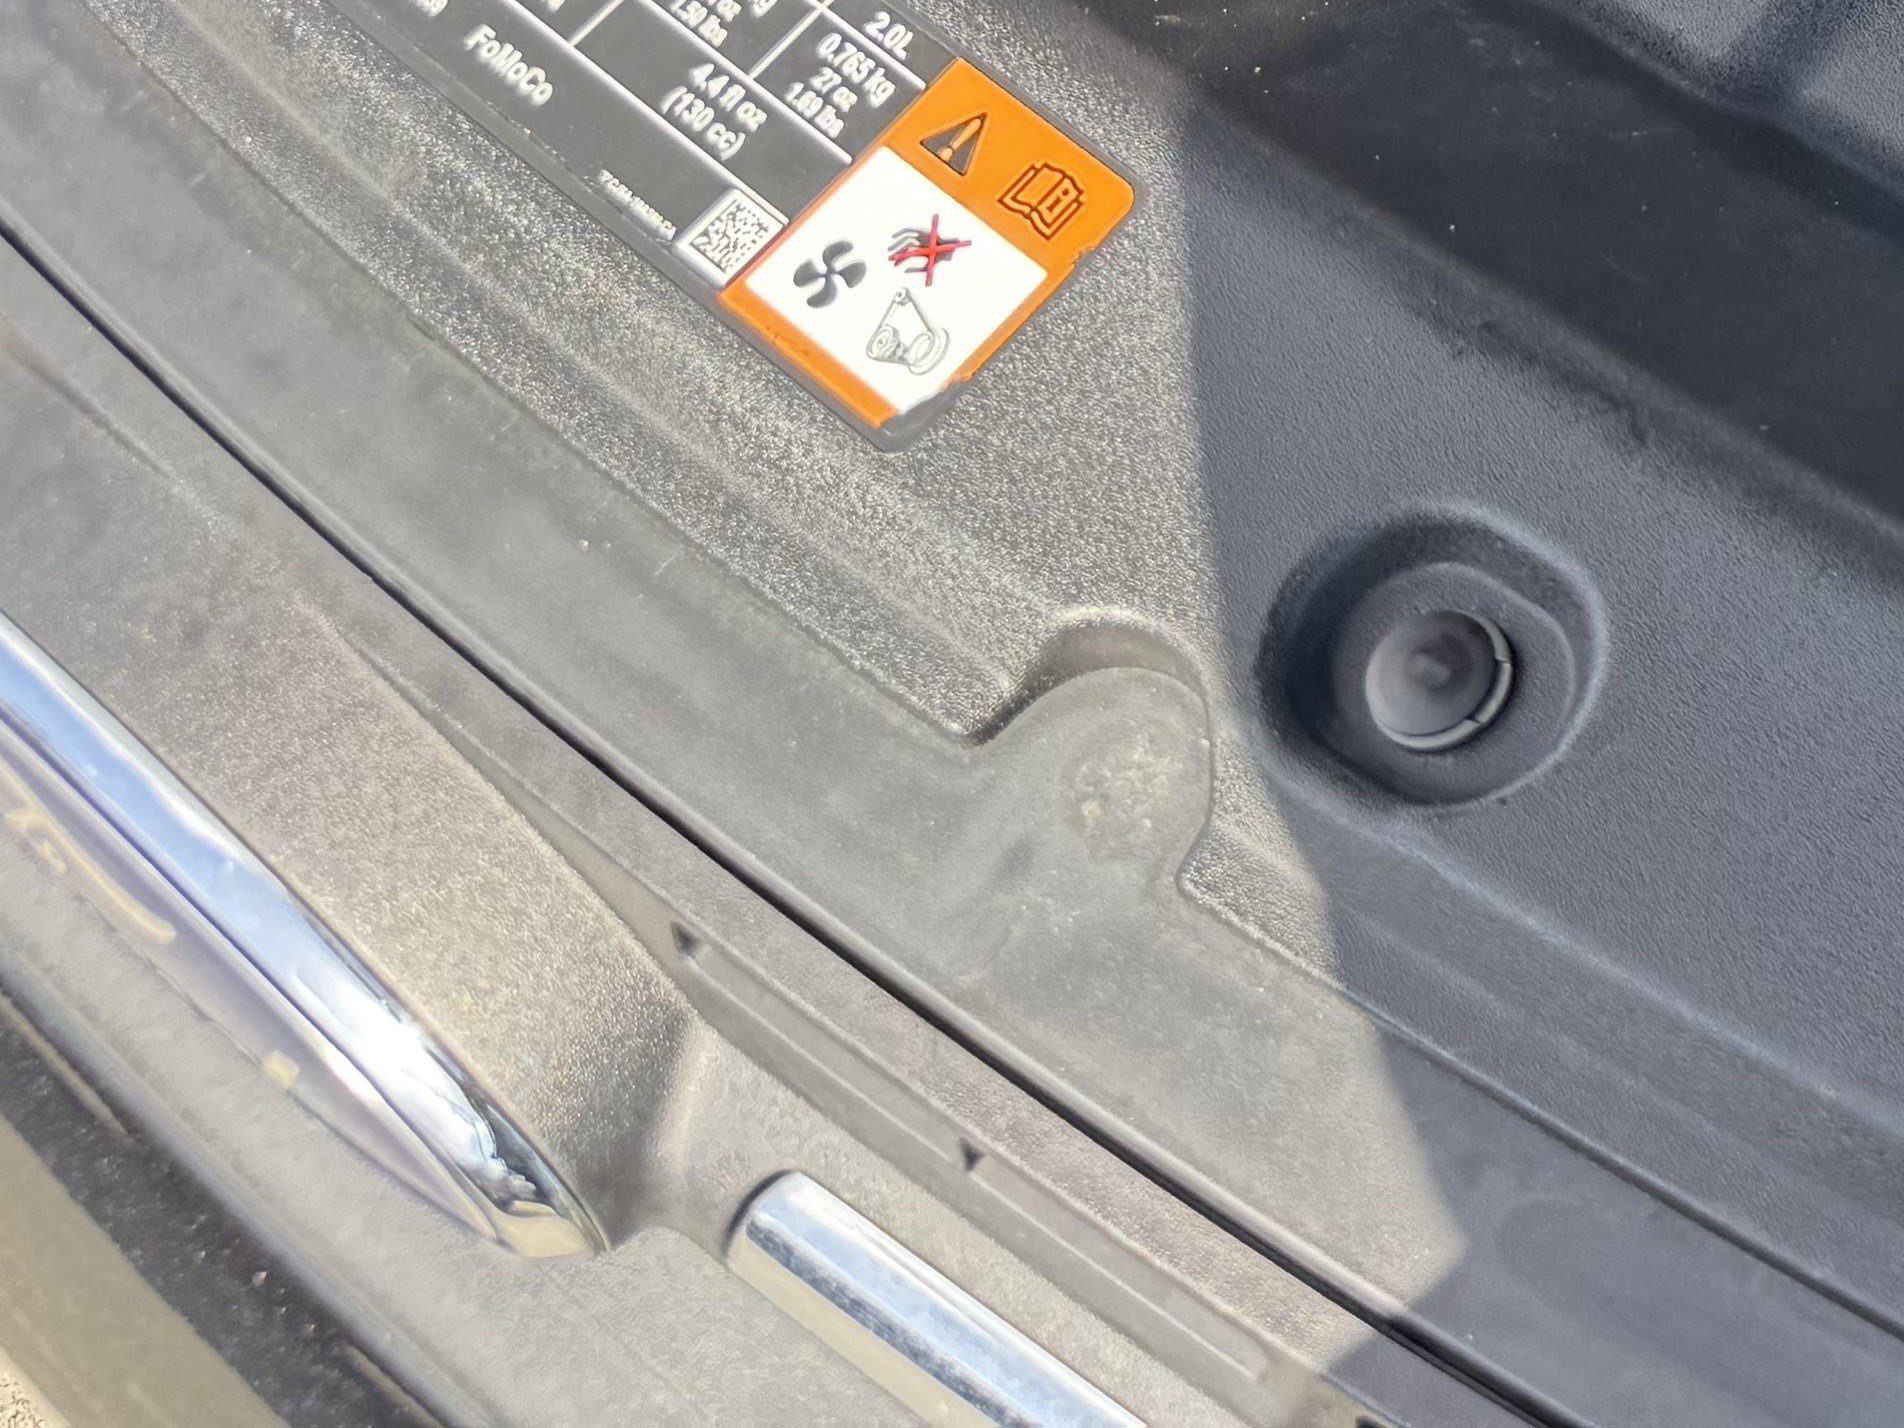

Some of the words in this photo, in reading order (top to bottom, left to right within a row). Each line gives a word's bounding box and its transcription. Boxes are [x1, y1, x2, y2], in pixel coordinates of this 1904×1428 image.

[697, 14, 727, 47] lbs
[862, 10, 913, 60] 2.0L
[462, 23, 553, 106] FoMoCo
[809, 66, 842, 94] 27
[829, 86, 857, 112] oz
[815, 32, 875, 84] 0.765
[861, 66, 895, 108] kg
[659, 85, 714, 131] (130
[704, 122, 745, 161] cc)
[688, 62, 729, 98] 4.4
[718, 83, 745, 112] fl
[733, 100, 767, 132] oz
[783, 81, 823, 118] 1.69
[813, 104, 844, 138] lbs
